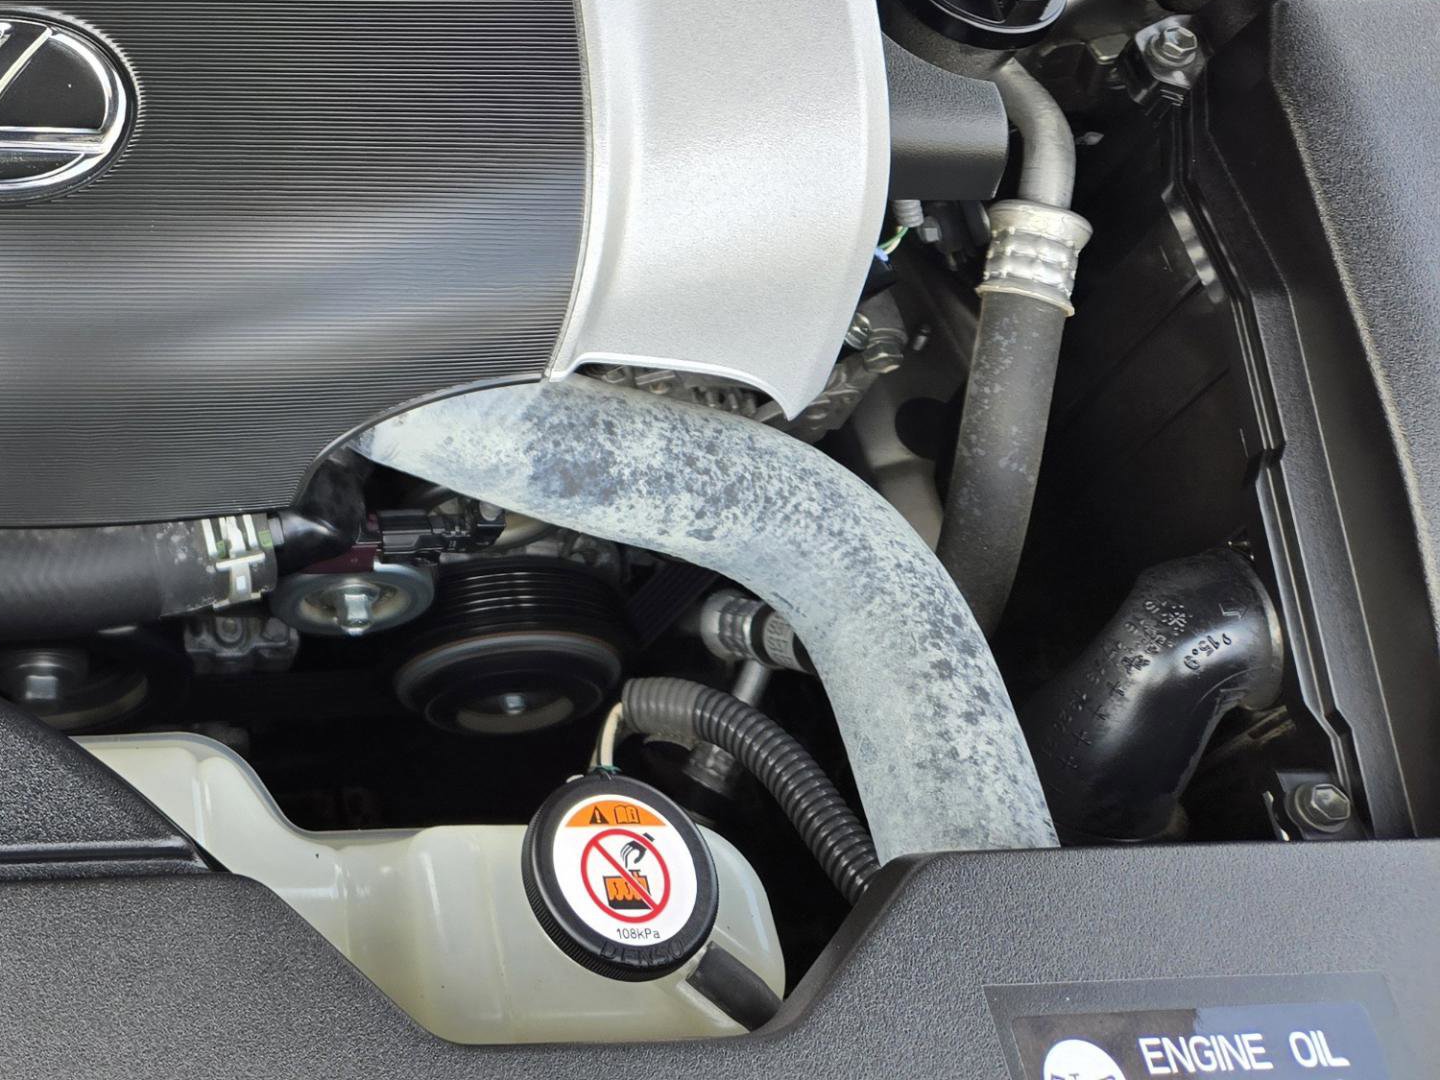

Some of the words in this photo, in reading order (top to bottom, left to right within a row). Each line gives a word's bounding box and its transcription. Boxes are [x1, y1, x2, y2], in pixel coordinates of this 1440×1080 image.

[616, 927, 661, 941] 108kPa
[1138, 1032, 1274, 1075] ENGINE
[1288, 1029, 1351, 1069] OIL
